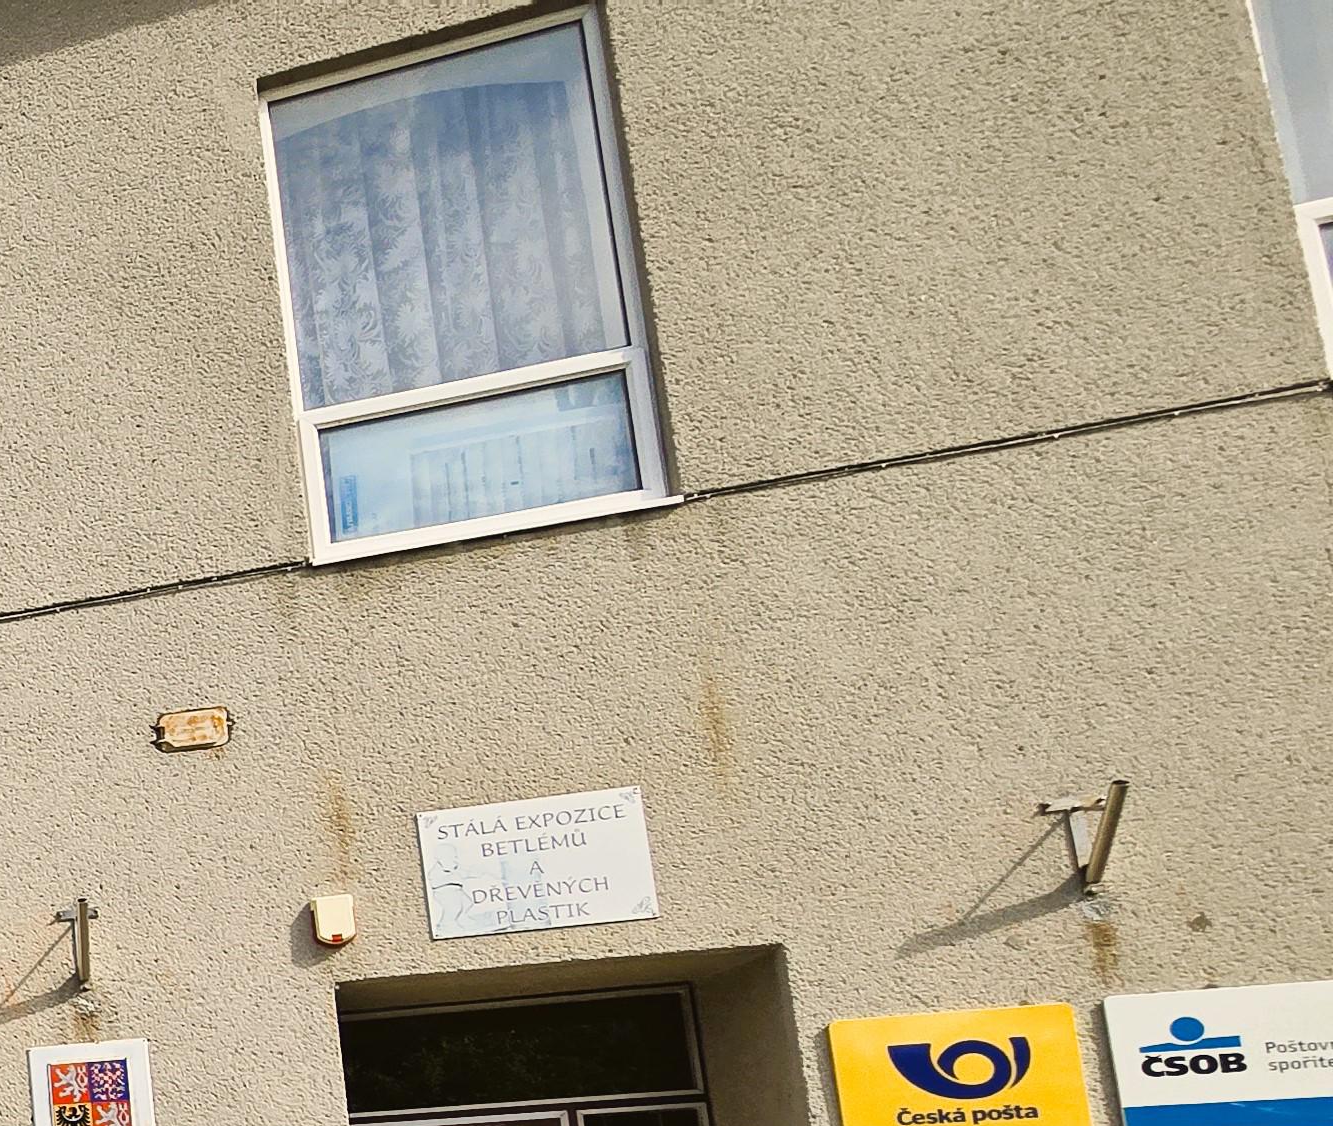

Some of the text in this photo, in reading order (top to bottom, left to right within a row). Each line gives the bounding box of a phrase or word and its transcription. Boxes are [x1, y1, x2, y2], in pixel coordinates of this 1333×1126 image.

[437, 803, 628, 840] STÁLÁ EXPOZICE
[480, 829, 587, 858] BETLÉMŮ
[529, 861, 545, 875] A
[471, 876, 610, 905] DŘEVĚNÝCH
[496, 902, 591, 925] PLASTIK
[1141, 1053, 1248, 1078] ČSOB
[896, 1104, 1039, 1126] Česká pošta
